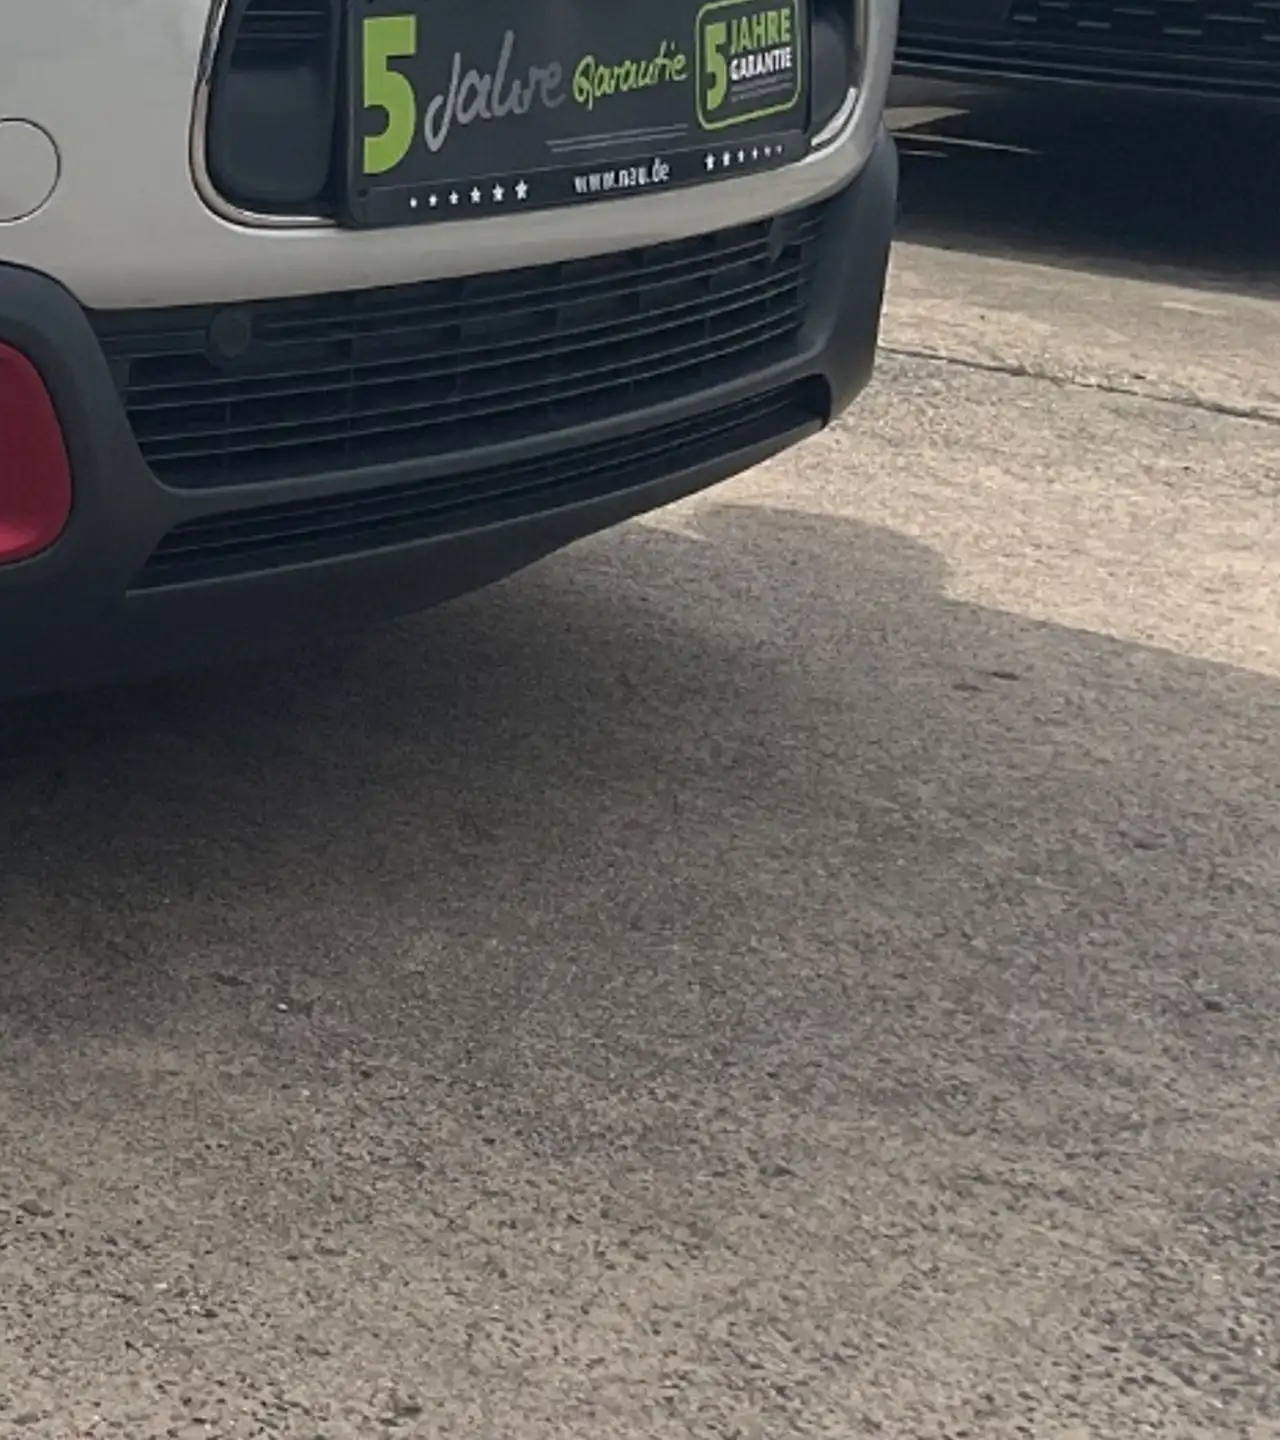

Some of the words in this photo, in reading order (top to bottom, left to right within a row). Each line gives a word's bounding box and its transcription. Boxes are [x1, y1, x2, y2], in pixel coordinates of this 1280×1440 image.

[363, 14, 417, 175] 5
[424, 29, 567, 152] Jahre
[573, 39, 690, 111] Garantie
[704, 21, 728, 111] 5
[730, 8, 792, 54] JAHRE
[730, 46, 793, 81] GARANTIE
[573, 157, 671, 195] www.nau.de
